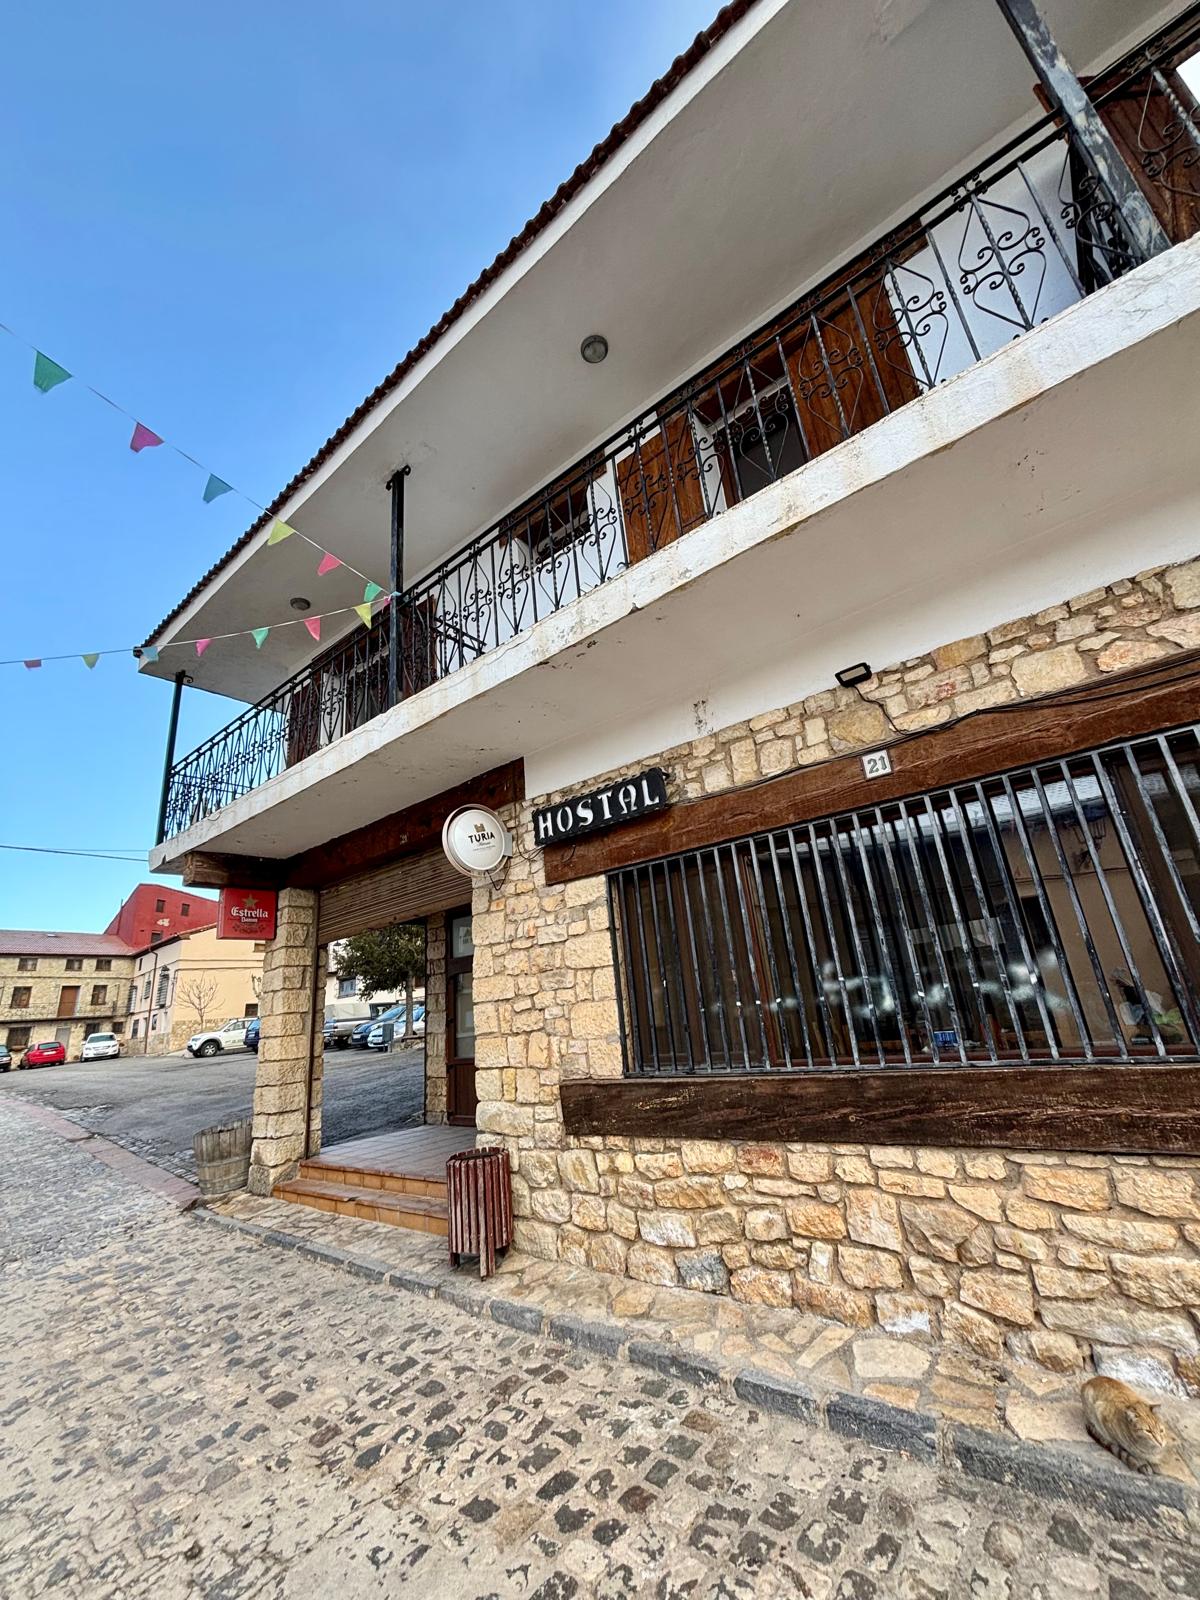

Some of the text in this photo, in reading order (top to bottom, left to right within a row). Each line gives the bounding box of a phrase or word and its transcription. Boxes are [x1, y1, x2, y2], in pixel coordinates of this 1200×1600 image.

[867, 755, 888, 774] 21
[538, 779, 659, 839] HOSTAL
[468, 832, 495, 843] TURIA
[231, 906, 269, 918] Estrella
